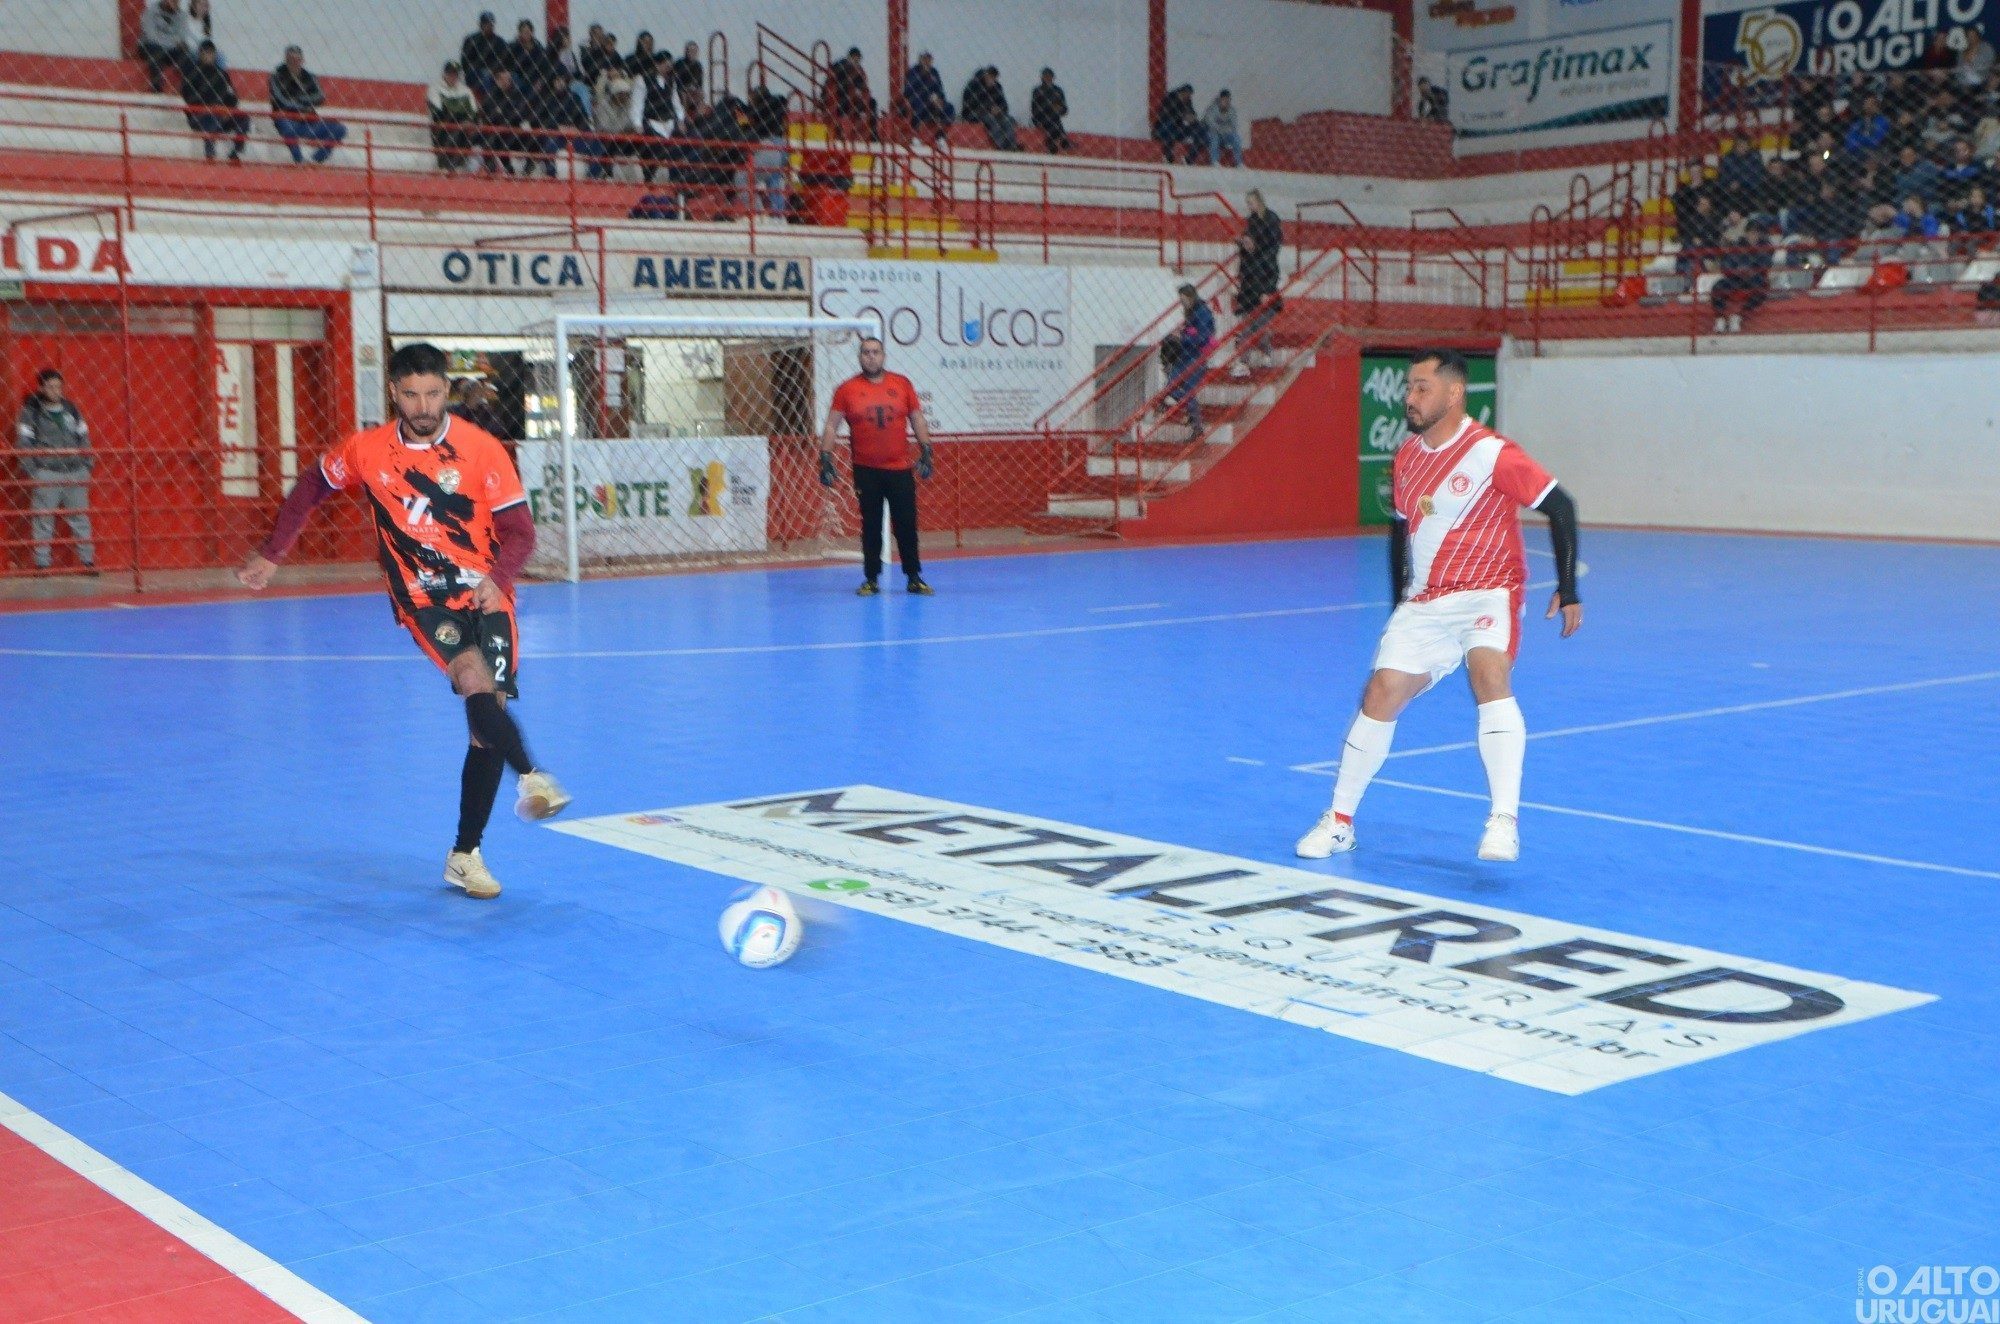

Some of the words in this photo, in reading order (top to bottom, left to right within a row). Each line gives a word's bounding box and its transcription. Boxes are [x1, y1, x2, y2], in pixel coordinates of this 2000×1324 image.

[1828, 1, 1863, 41] O
[1461, 43, 1654, 103] Grafimax
[494, 656, 506, 681] 2
[724, 791, 1847, 1025] METALFRED
[1145, 909, 1719, 1050] ESQUADRIAS
